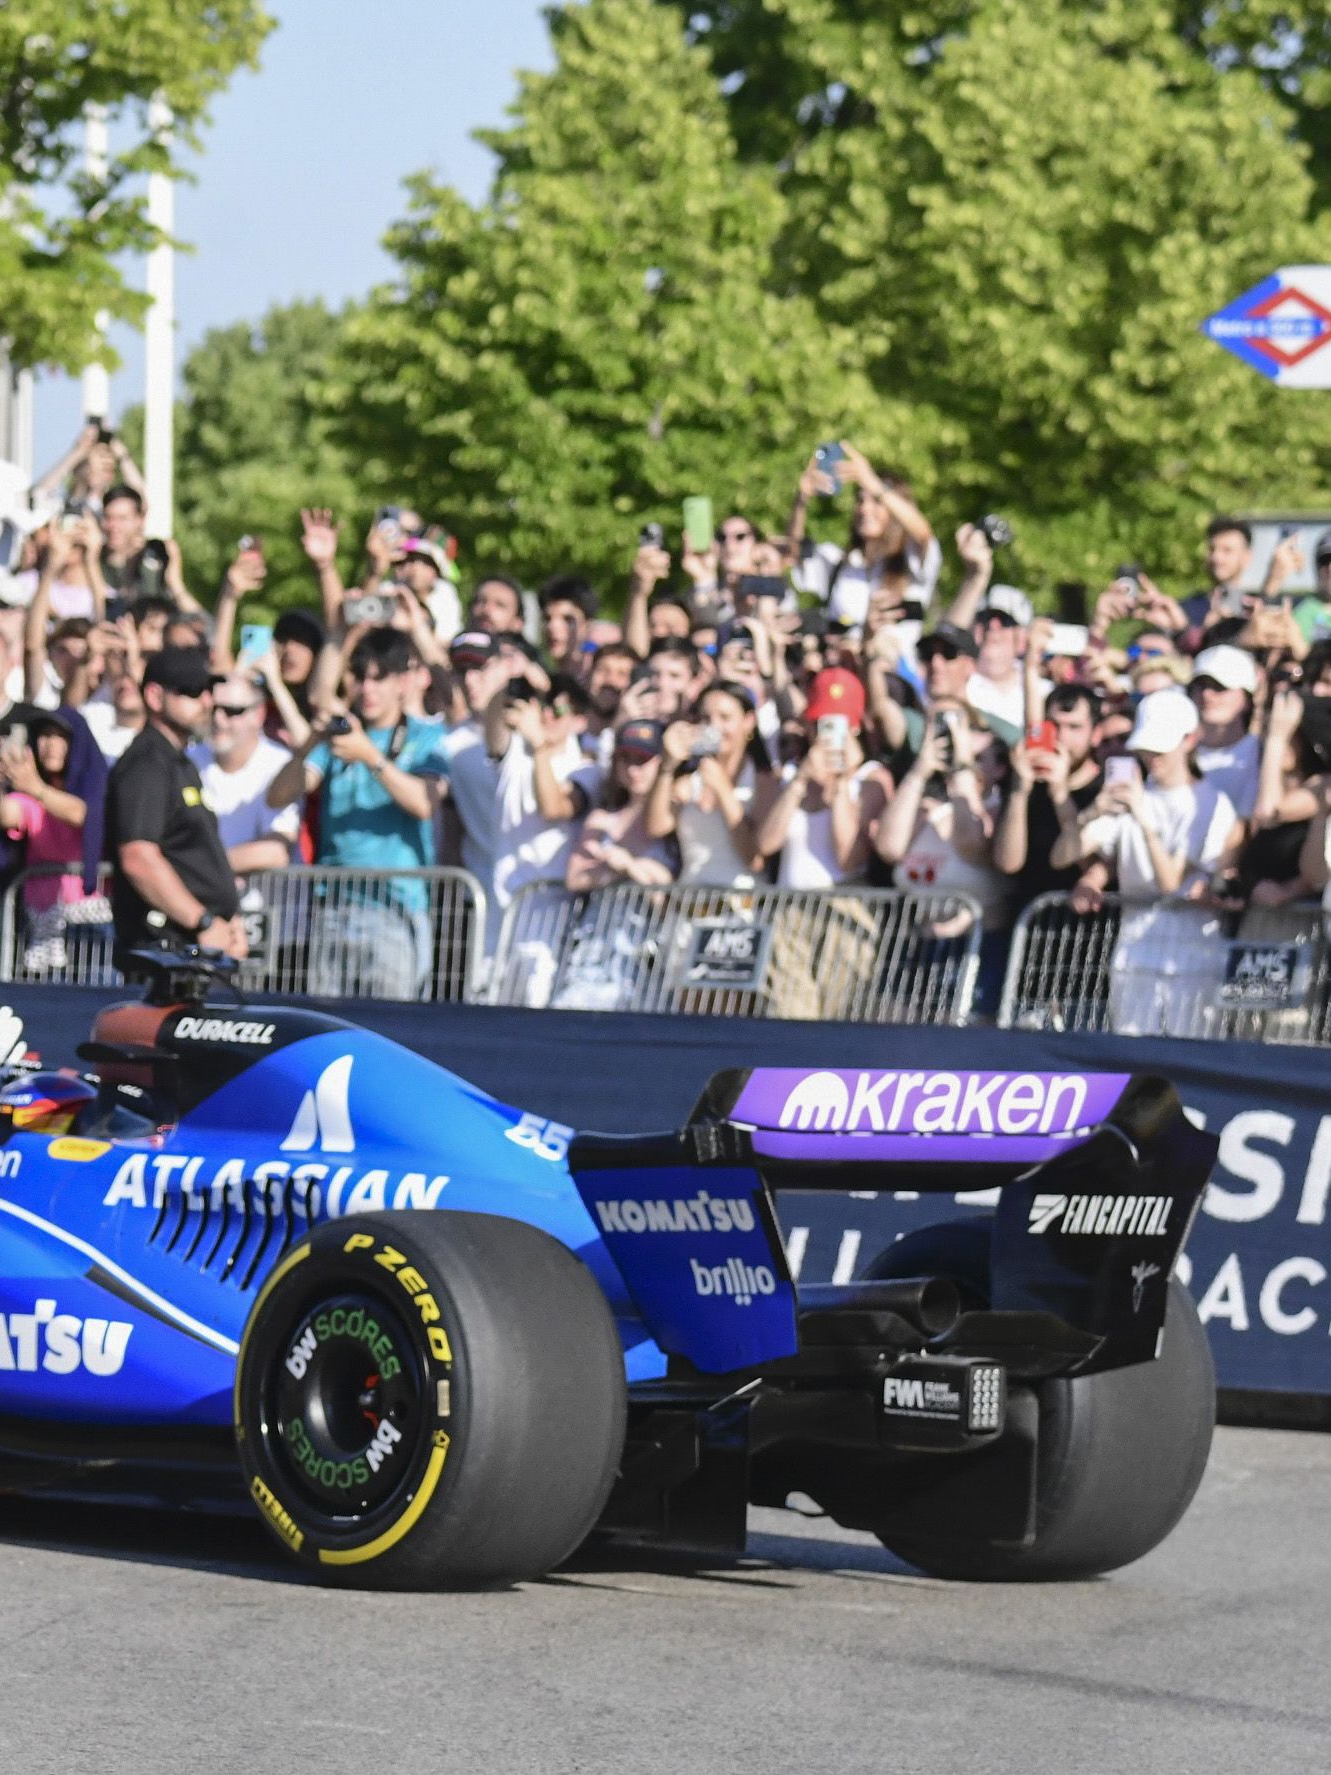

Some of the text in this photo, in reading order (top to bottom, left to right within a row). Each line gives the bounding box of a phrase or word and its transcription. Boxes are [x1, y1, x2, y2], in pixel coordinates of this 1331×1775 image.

[174, 1017, 276, 1045] DURACELL
[846, 1072, 1088, 1134] kraken
[102, 1153, 451, 1219] ATLASSIAN
[595, 1190, 755, 1233] KOMATSU
[1061, 1195, 1173, 1235] FANCAPITAL
[373, 1245, 453, 1362] ZERO
[315, 1308, 402, 1381] SCORES
[289, 1417, 370, 1489] SCORES
